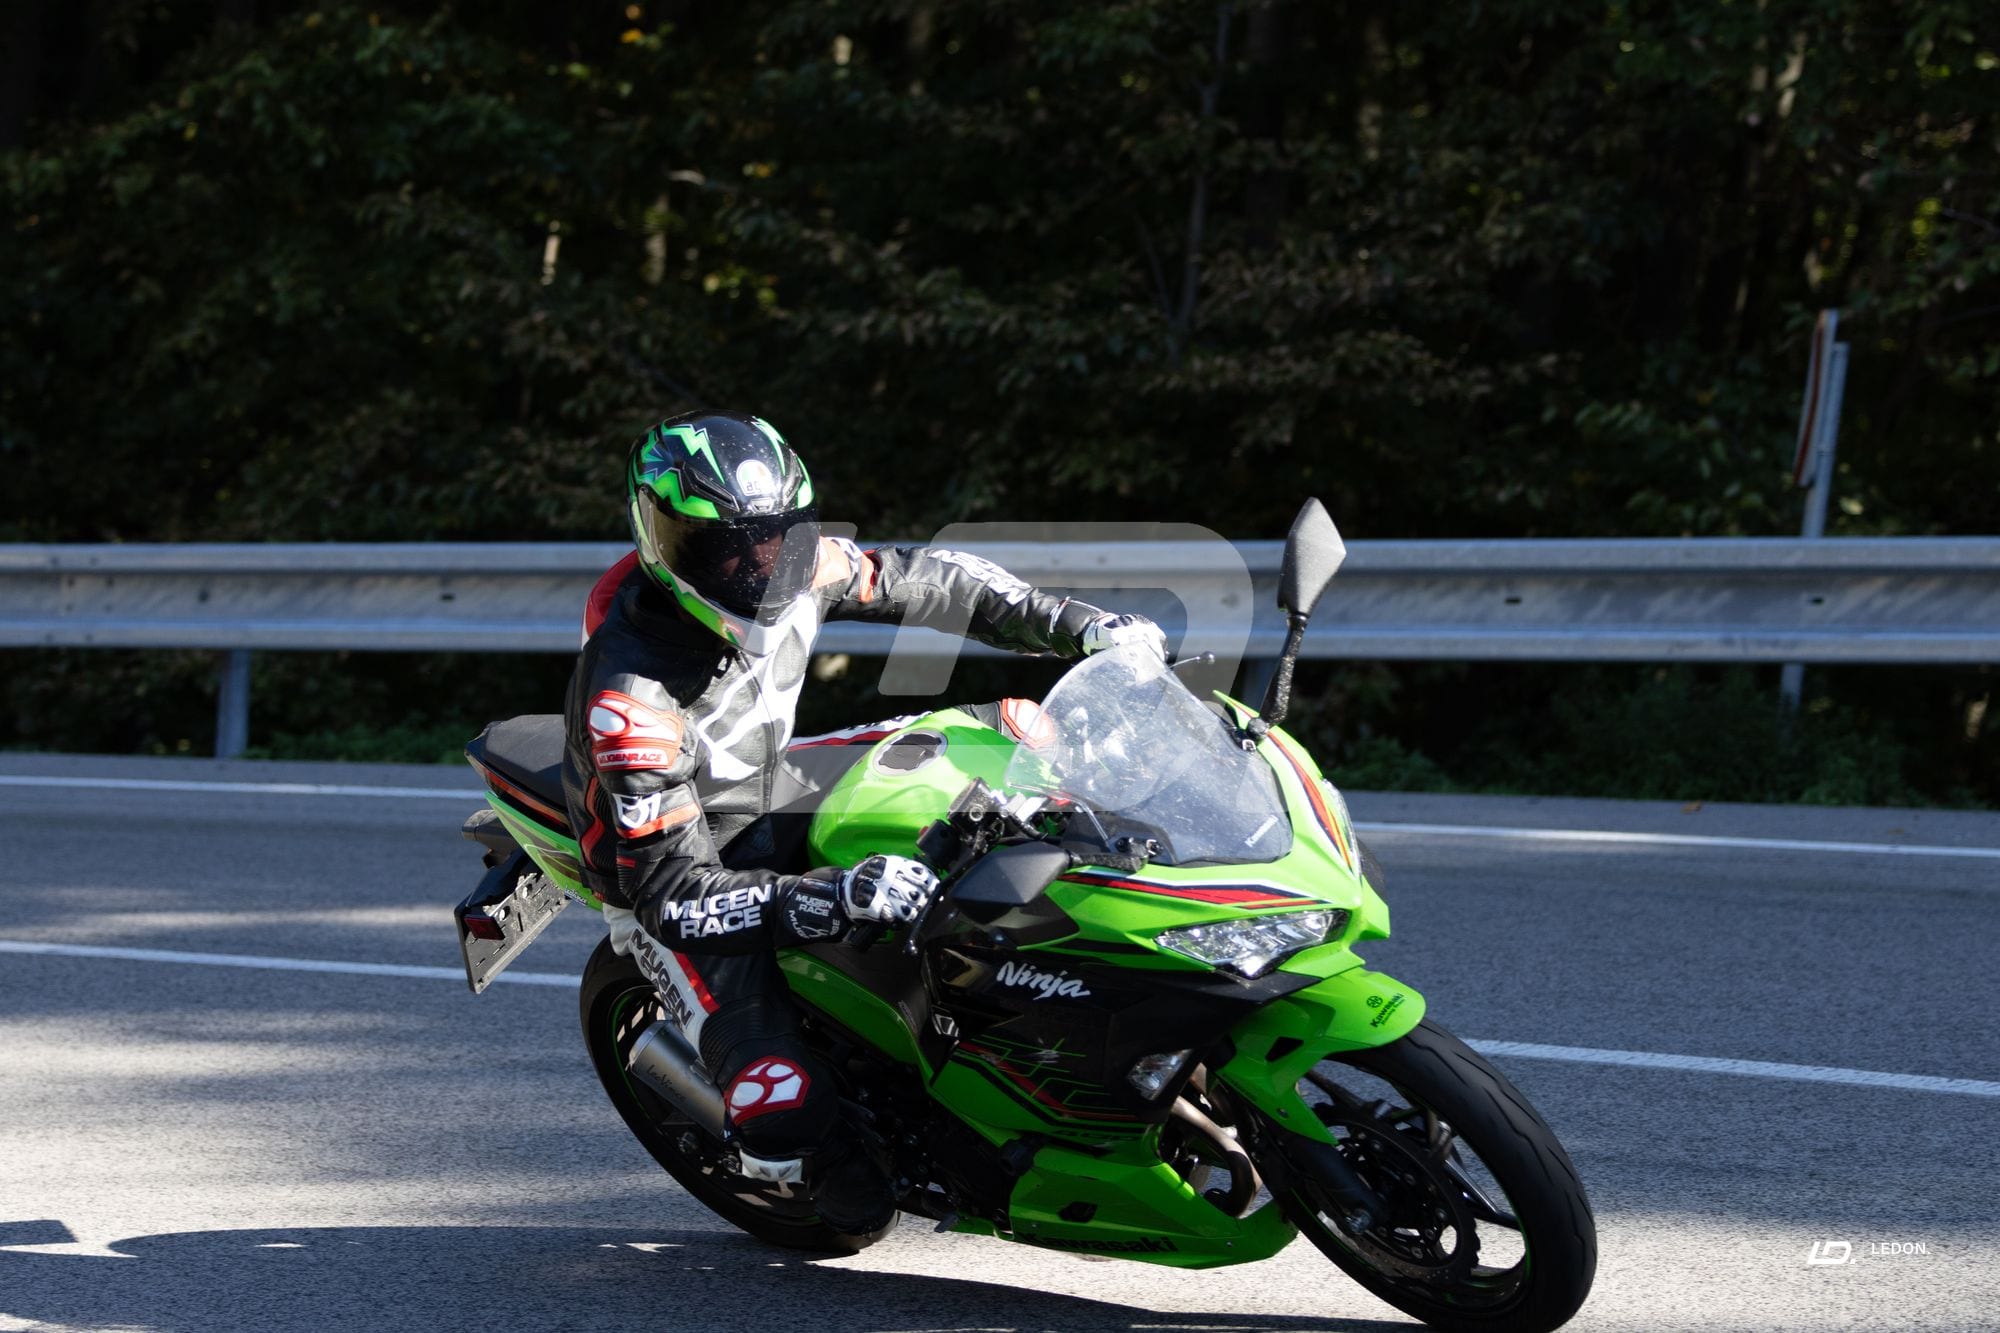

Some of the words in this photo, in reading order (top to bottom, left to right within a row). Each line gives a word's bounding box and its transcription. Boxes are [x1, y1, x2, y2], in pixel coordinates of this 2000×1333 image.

[663, 883, 772, 920] MUGEN
[795, 894, 834, 909] MUGEN
[798, 903, 829, 917] RACE
[680, 905, 762, 939] RACE
[629, 927, 693, 1026] MUGEN
[996, 961, 1091, 1001] Ninja
